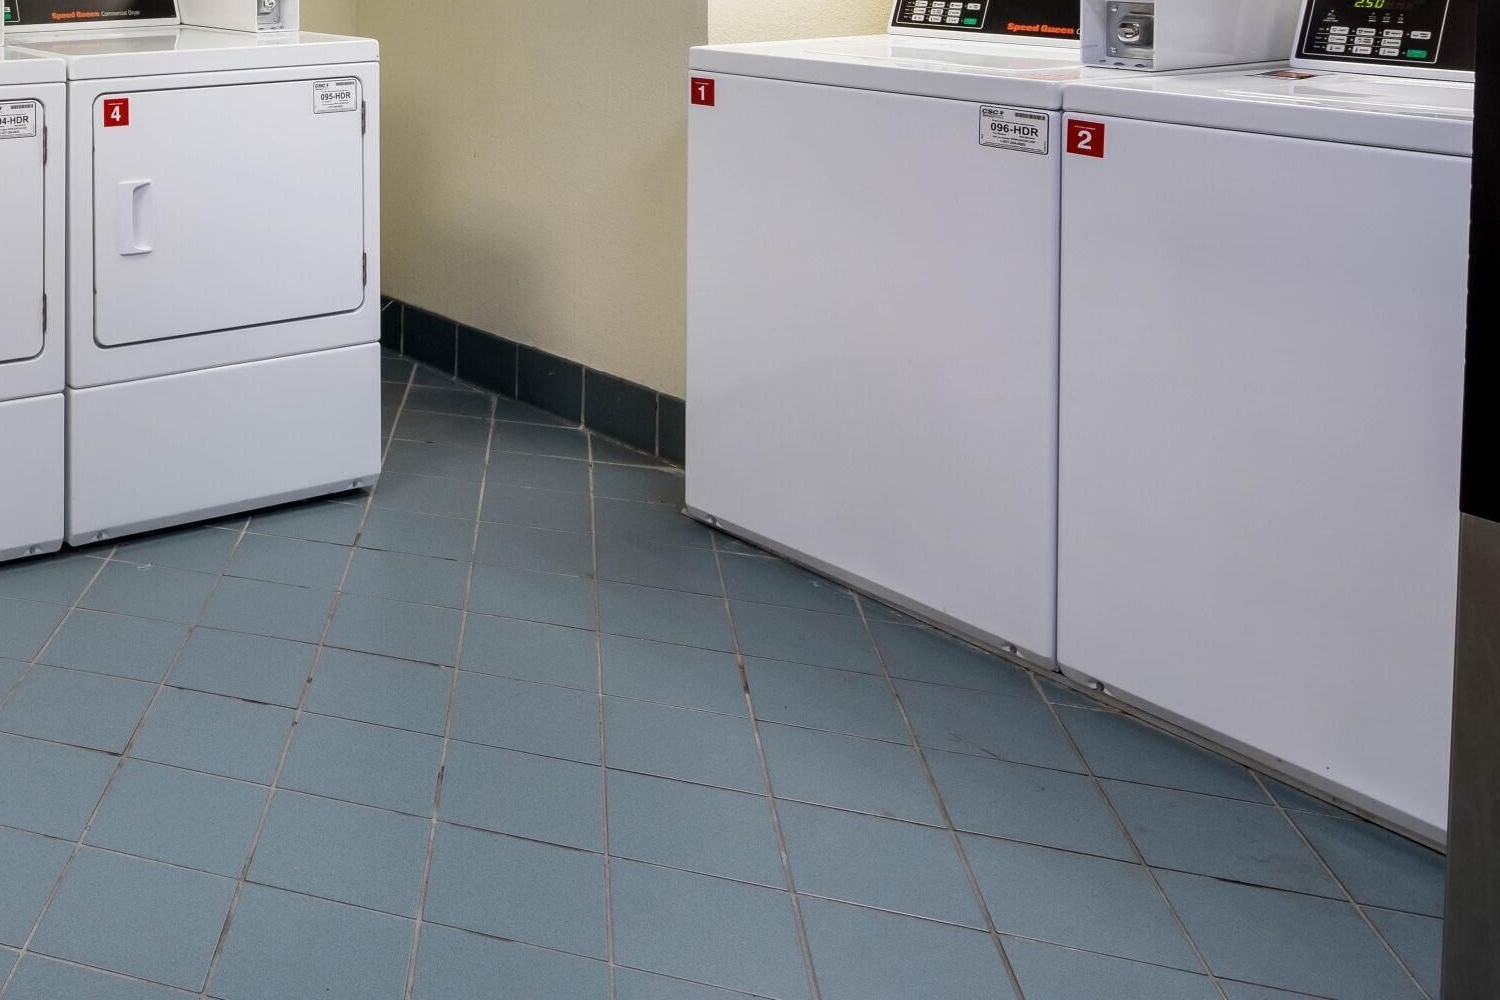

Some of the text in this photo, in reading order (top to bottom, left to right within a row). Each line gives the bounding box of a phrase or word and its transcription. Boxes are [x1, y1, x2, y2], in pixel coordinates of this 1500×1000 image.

[1007, 23, 1074, 34] Speed Queen
[321, 92, 350, 100] 095-HDR
[698, 86, 704, 100] 1
[111, 106, 121, 121] 4
[991, 122, 1039, 137] 096-HDR
[1078, 130, 1091, 150] 2
